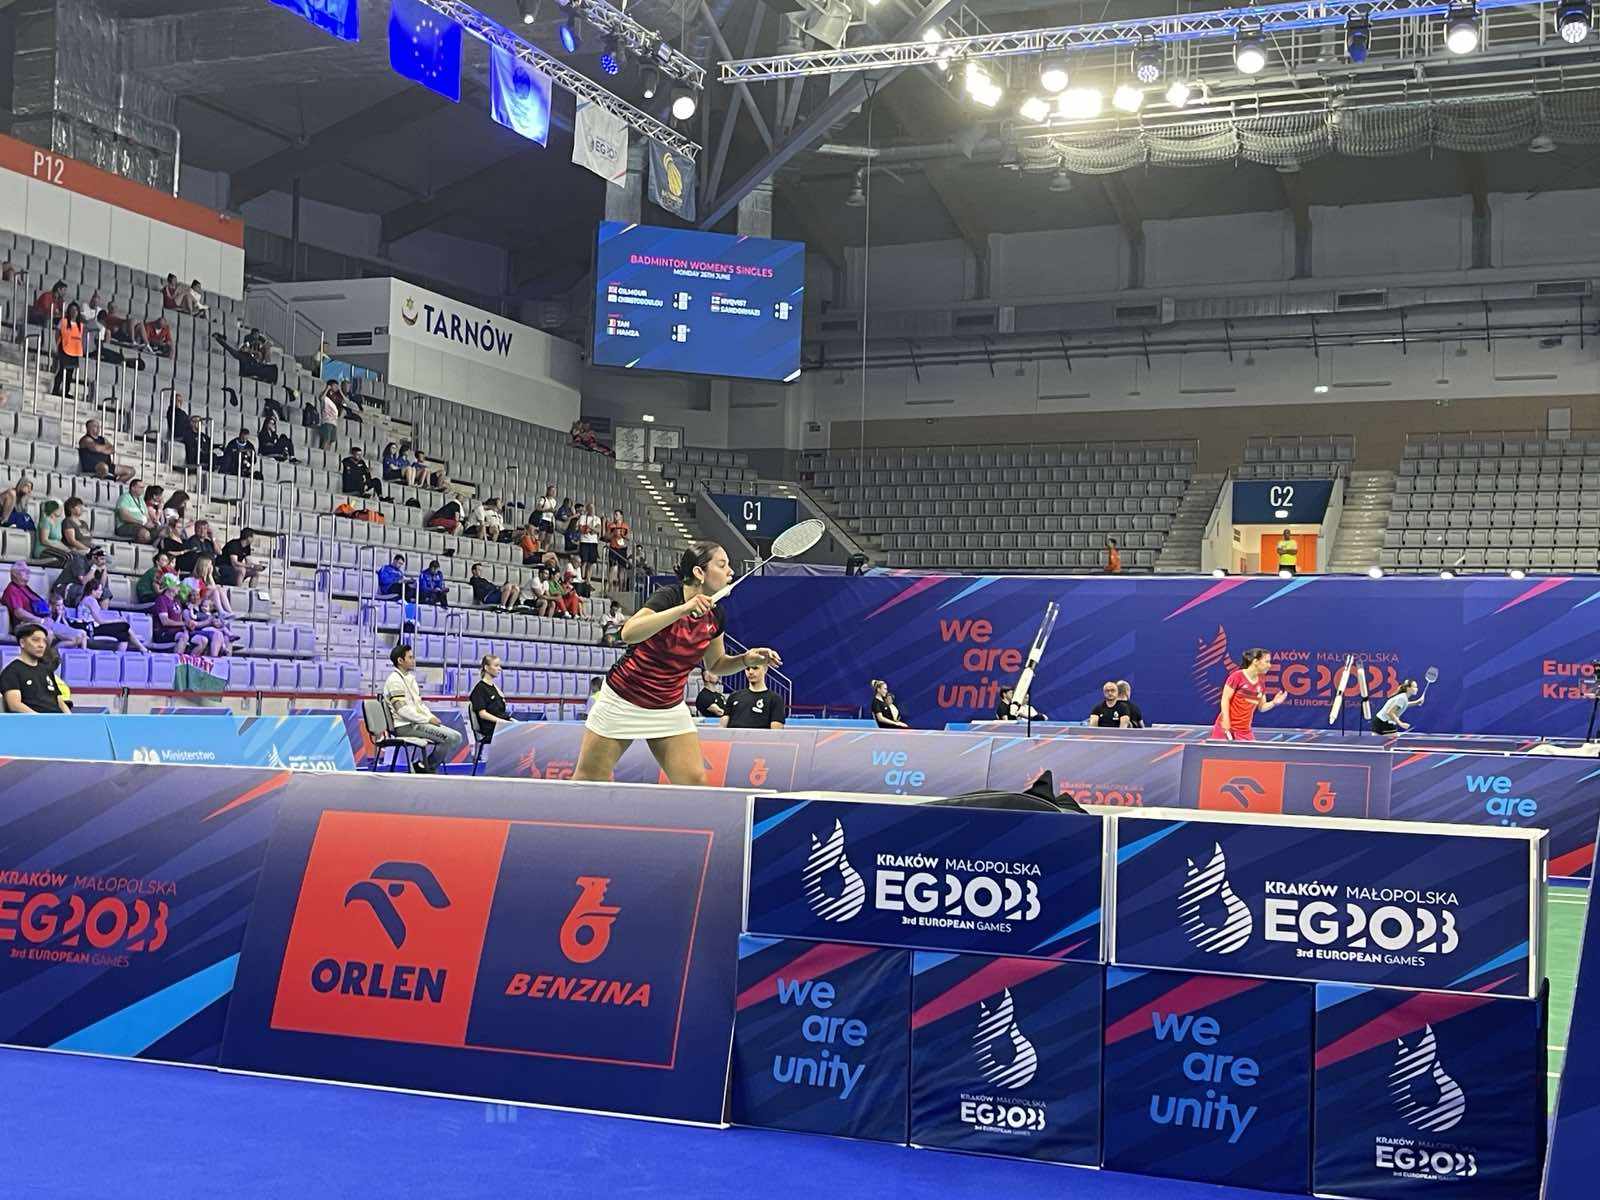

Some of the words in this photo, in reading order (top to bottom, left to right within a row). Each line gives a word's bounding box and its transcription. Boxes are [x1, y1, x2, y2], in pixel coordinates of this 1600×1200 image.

[33, 151, 65, 185] P12
[630, 254, 687, 269] BADMINTON
[690, 260, 734, 274] WOMEN'S
[736, 265, 773, 278] SINGLES
[673, 268, 699, 277] MONDAY
[424, 304, 512, 358] TARNÓW
[617, 320, 630, 328] TAN
[1270, 485, 1294, 507] C2
[743, 500, 761, 521] C1
[940, 618, 993, 643] we
[963, 647, 1022, 673] are
[938, 677, 1000, 709] unit
[161, 749, 216, 761] Ministerstwo
[871, 750, 908, 767] we
[884, 769, 925, 787] are
[1466, 775, 1512, 794] we
[1485, 796, 1538, 817] are
[876, 853, 939, 869] KRAKÓW
[945, 858, 1042, 876] MAŁOPOLSKA
[0, 869, 68, 888] KRAKÓW
[73, 875, 177, 897] MAŁOPOLSKA
[875, 870, 1042, 921] EG2023
[1265, 880, 1338, 897] KRAKÓW
[1346, 885, 1459, 906] MAŁOPOLSKA
[901, 916, 917, 926] 3rd
[918, 917, 975, 930] EUROPEAN
[976, 921, 1012, 933] GAMES
[1264, 898, 1460, 954] EG2023
[10, 948, 26, 959] 3rd
[28, 949, 90, 964] EUROPEAN
[91, 953, 129, 968] GAMES
[1296, 948, 1314, 959] 3rd
[1316, 949, 1382, 964] EUROPEAN
[1384, 954, 1426, 967] GAMES
[311, 958, 447, 1003] ORLEN
[505, 973, 651, 1008] BENZINA
[776, 976, 836, 1009] we
[802, 1014, 867, 1047] are
[1151, 1011, 1221, 1046] we
[773, 1050, 866, 1100] unity
[1183, 1051, 1260, 1087] are
[961, 1101, 1046, 1131] EG2023
[1150, 1089, 1258, 1144] unity
[1376, 1136, 1415, 1146] KRAKÓW
[1376, 1145, 1478, 1177] EG2023
